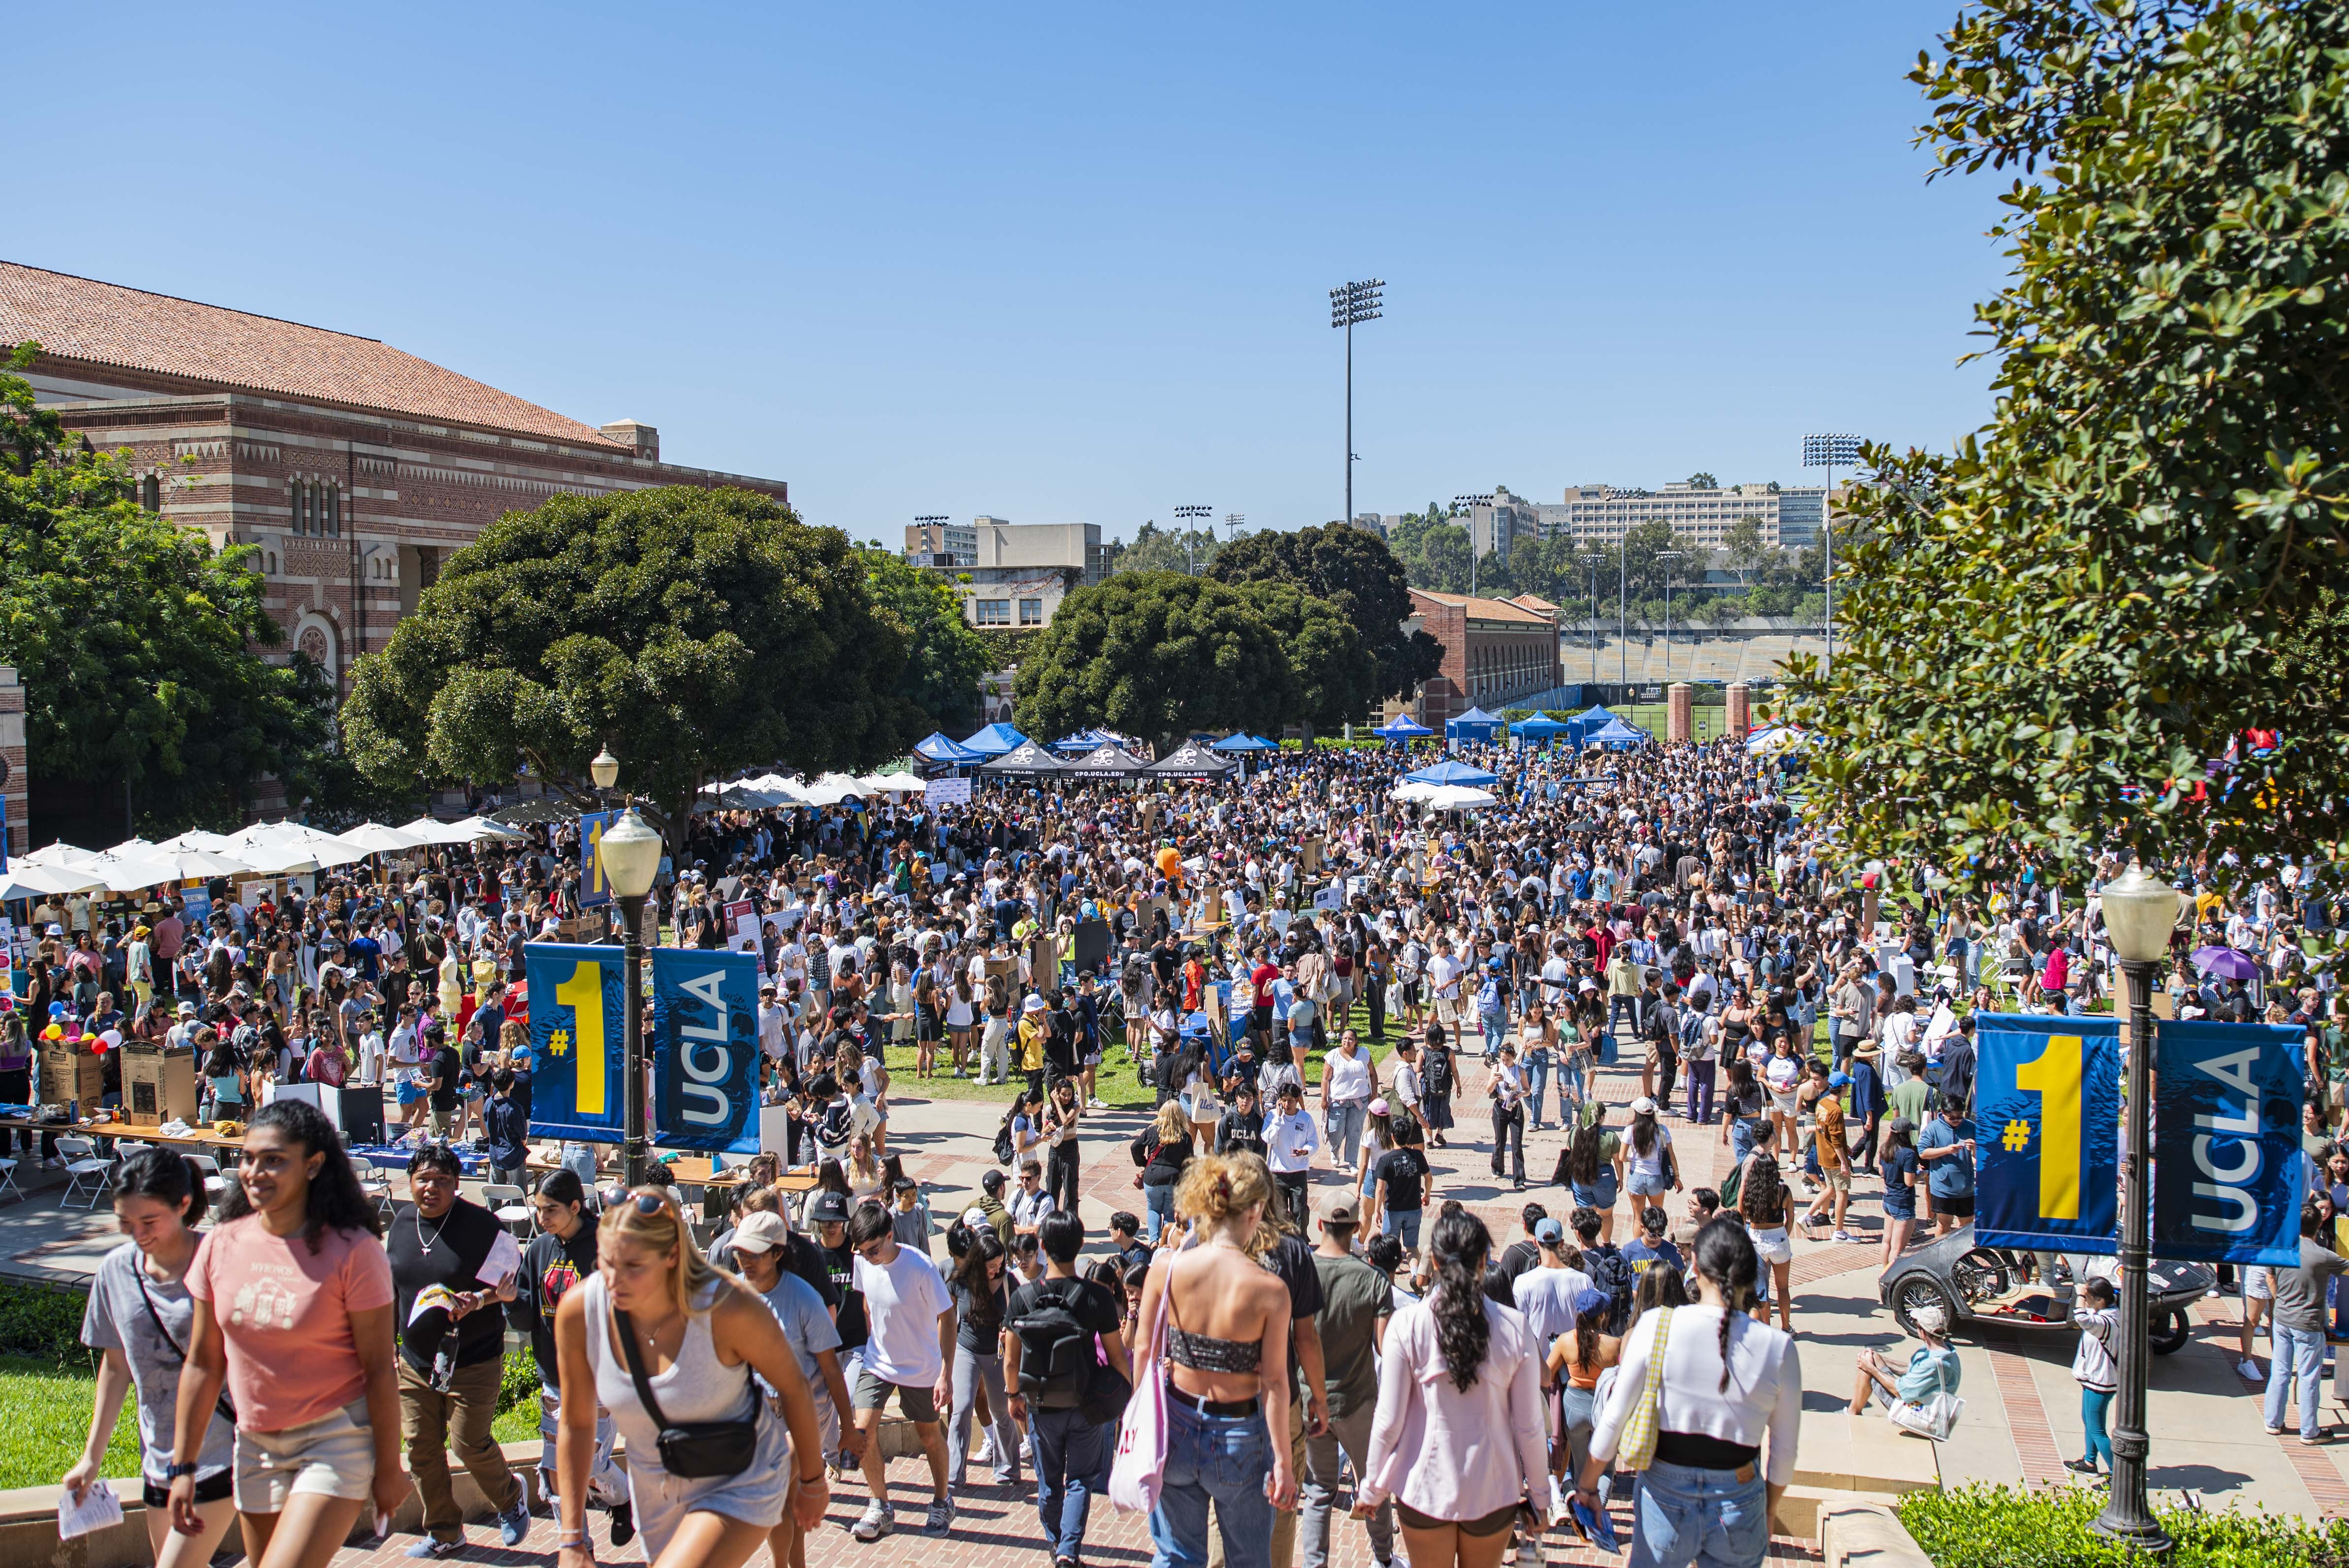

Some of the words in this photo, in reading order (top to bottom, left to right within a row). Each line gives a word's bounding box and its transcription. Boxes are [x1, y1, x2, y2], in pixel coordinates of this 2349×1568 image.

[287, 877, 298, 885] et!
[549, 961, 605, 1114] #1
[679, 969, 729, 1125] UCLA
[1200, 1098, 1214, 1110] Uca
[1232, 1129, 1256, 1140] UCLA
[2002, 1035, 2082, 1220] #1
[2191, 1046, 2260, 1231] UCLA
